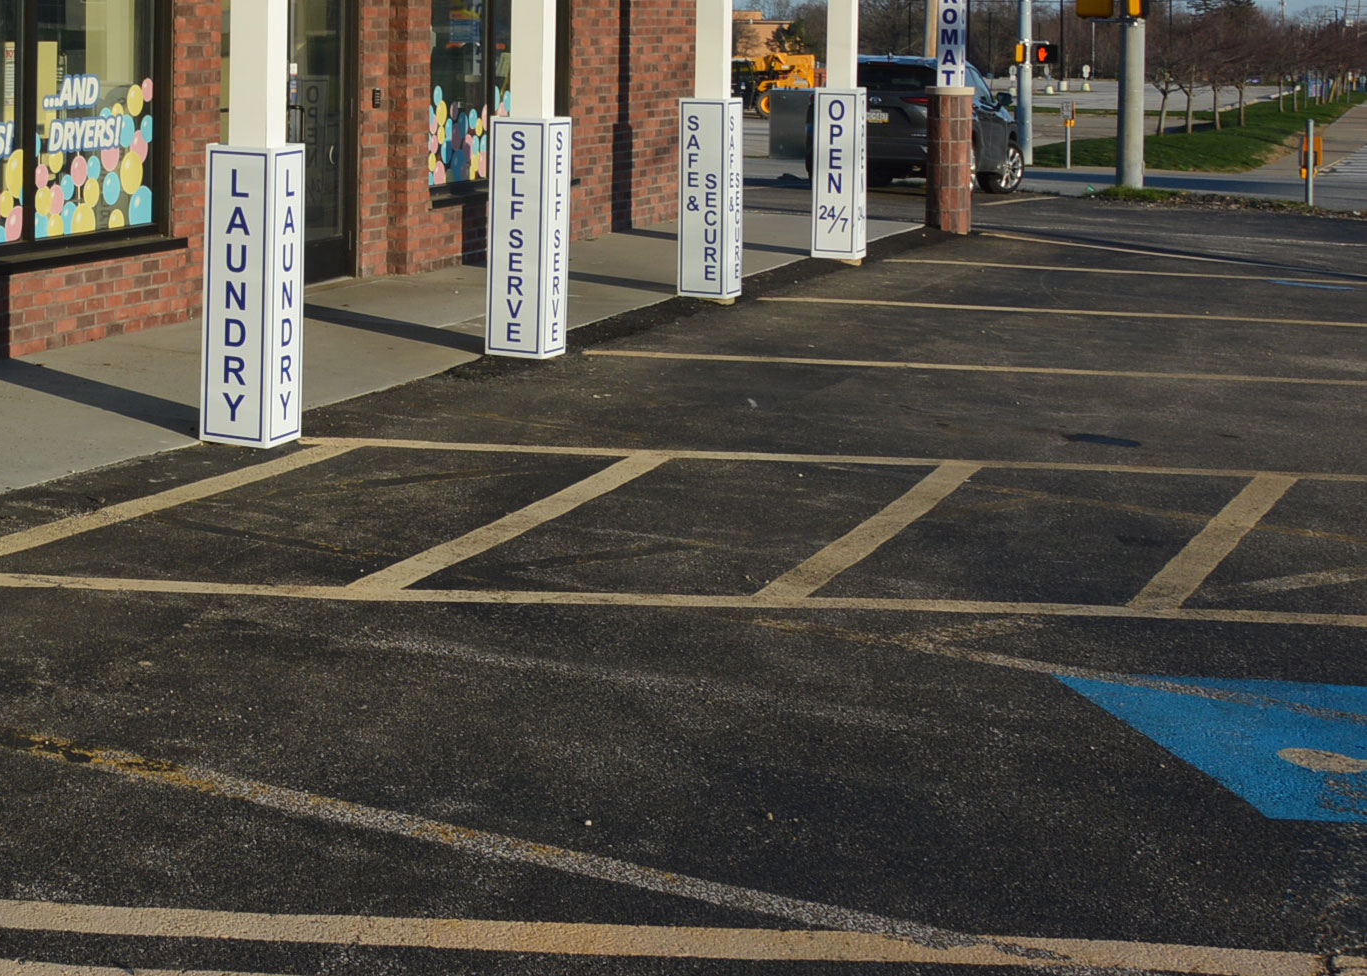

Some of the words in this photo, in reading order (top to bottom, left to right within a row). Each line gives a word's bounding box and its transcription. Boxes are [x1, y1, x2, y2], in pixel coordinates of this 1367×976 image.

[48, 115, 122, 152] DRYERS!
[510, 130, 526, 221] SELF
[555, 130, 563, 221] SELF
[686, 115, 700, 188] SAFE
[827, 99, 845, 195] OPEN
[686, 195, 700, 212] &
[704, 173, 717, 281] SECURE
[818, 204, 849, 234] 24/7
[222, 168, 250, 422] LAUNDRY
[279, 168, 295, 421] LAUNDRY
[506, 228, 524, 343] SERVE
[551, 228, 561, 343] SERVE
